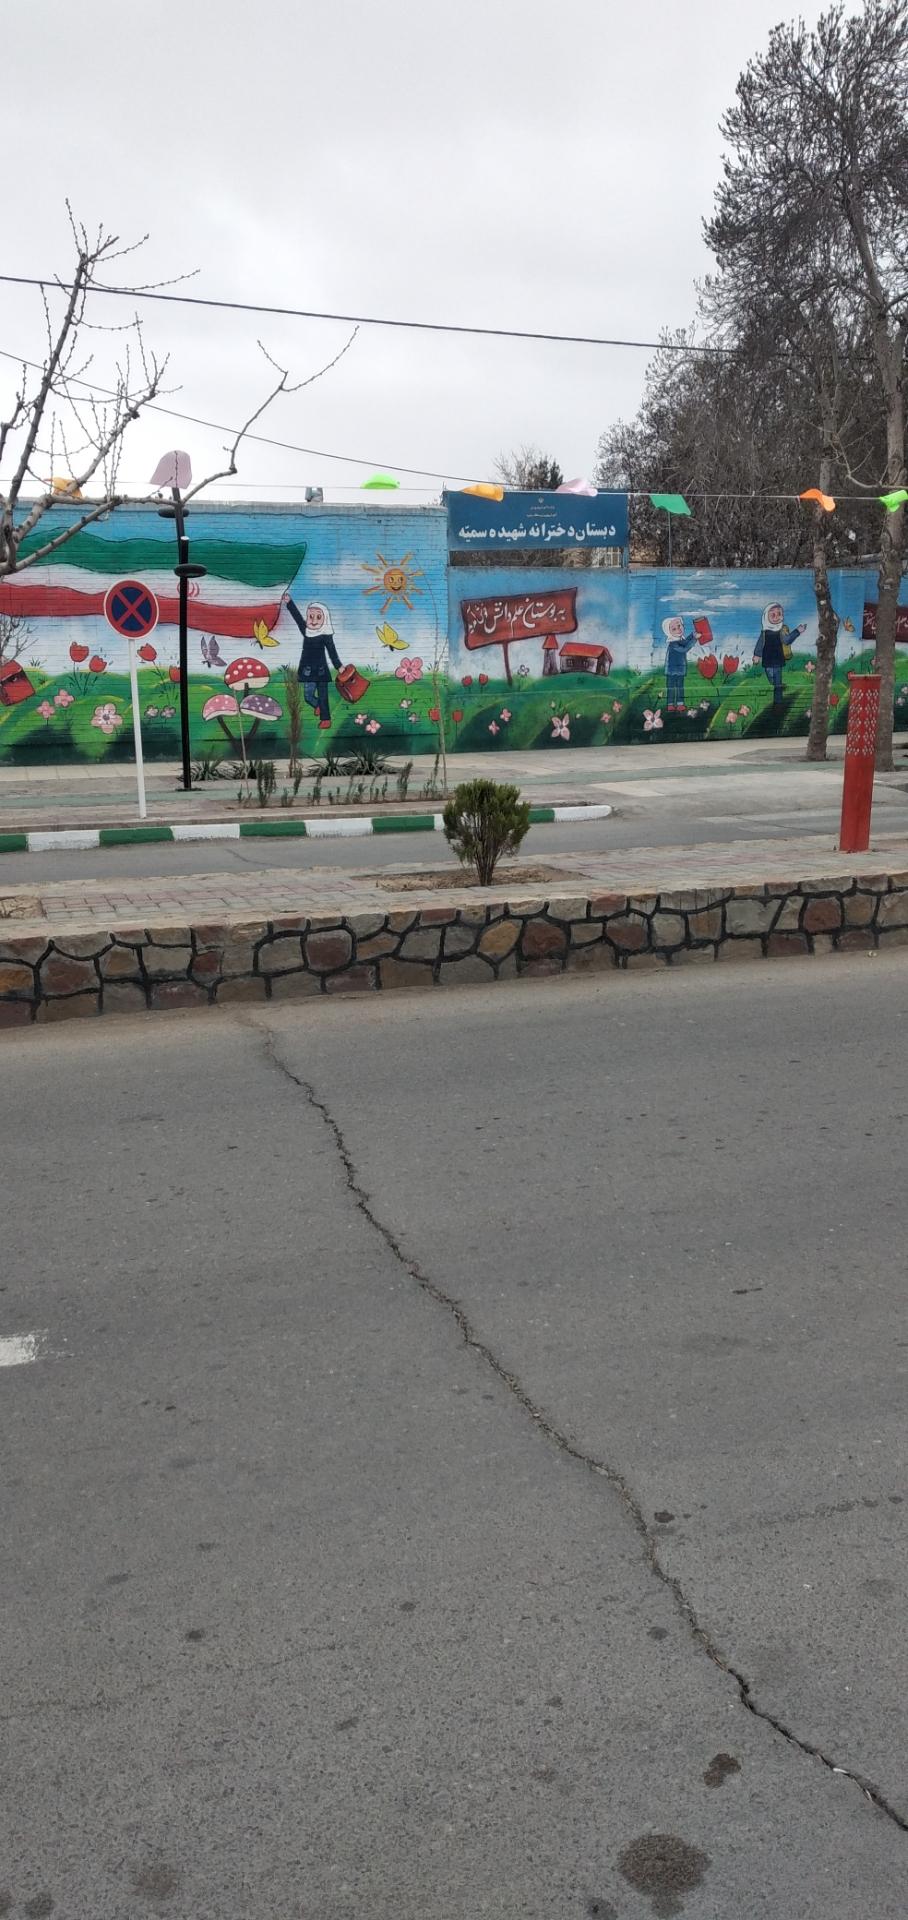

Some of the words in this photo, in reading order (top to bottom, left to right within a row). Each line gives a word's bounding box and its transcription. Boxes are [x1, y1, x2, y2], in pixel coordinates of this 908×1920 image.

[489, 522, 527, 542] شهیده
[528, 522, 575, 542] دخترانه
[575, 522, 617, 541] دبستان
[523, 598, 557, 629] بوستان
